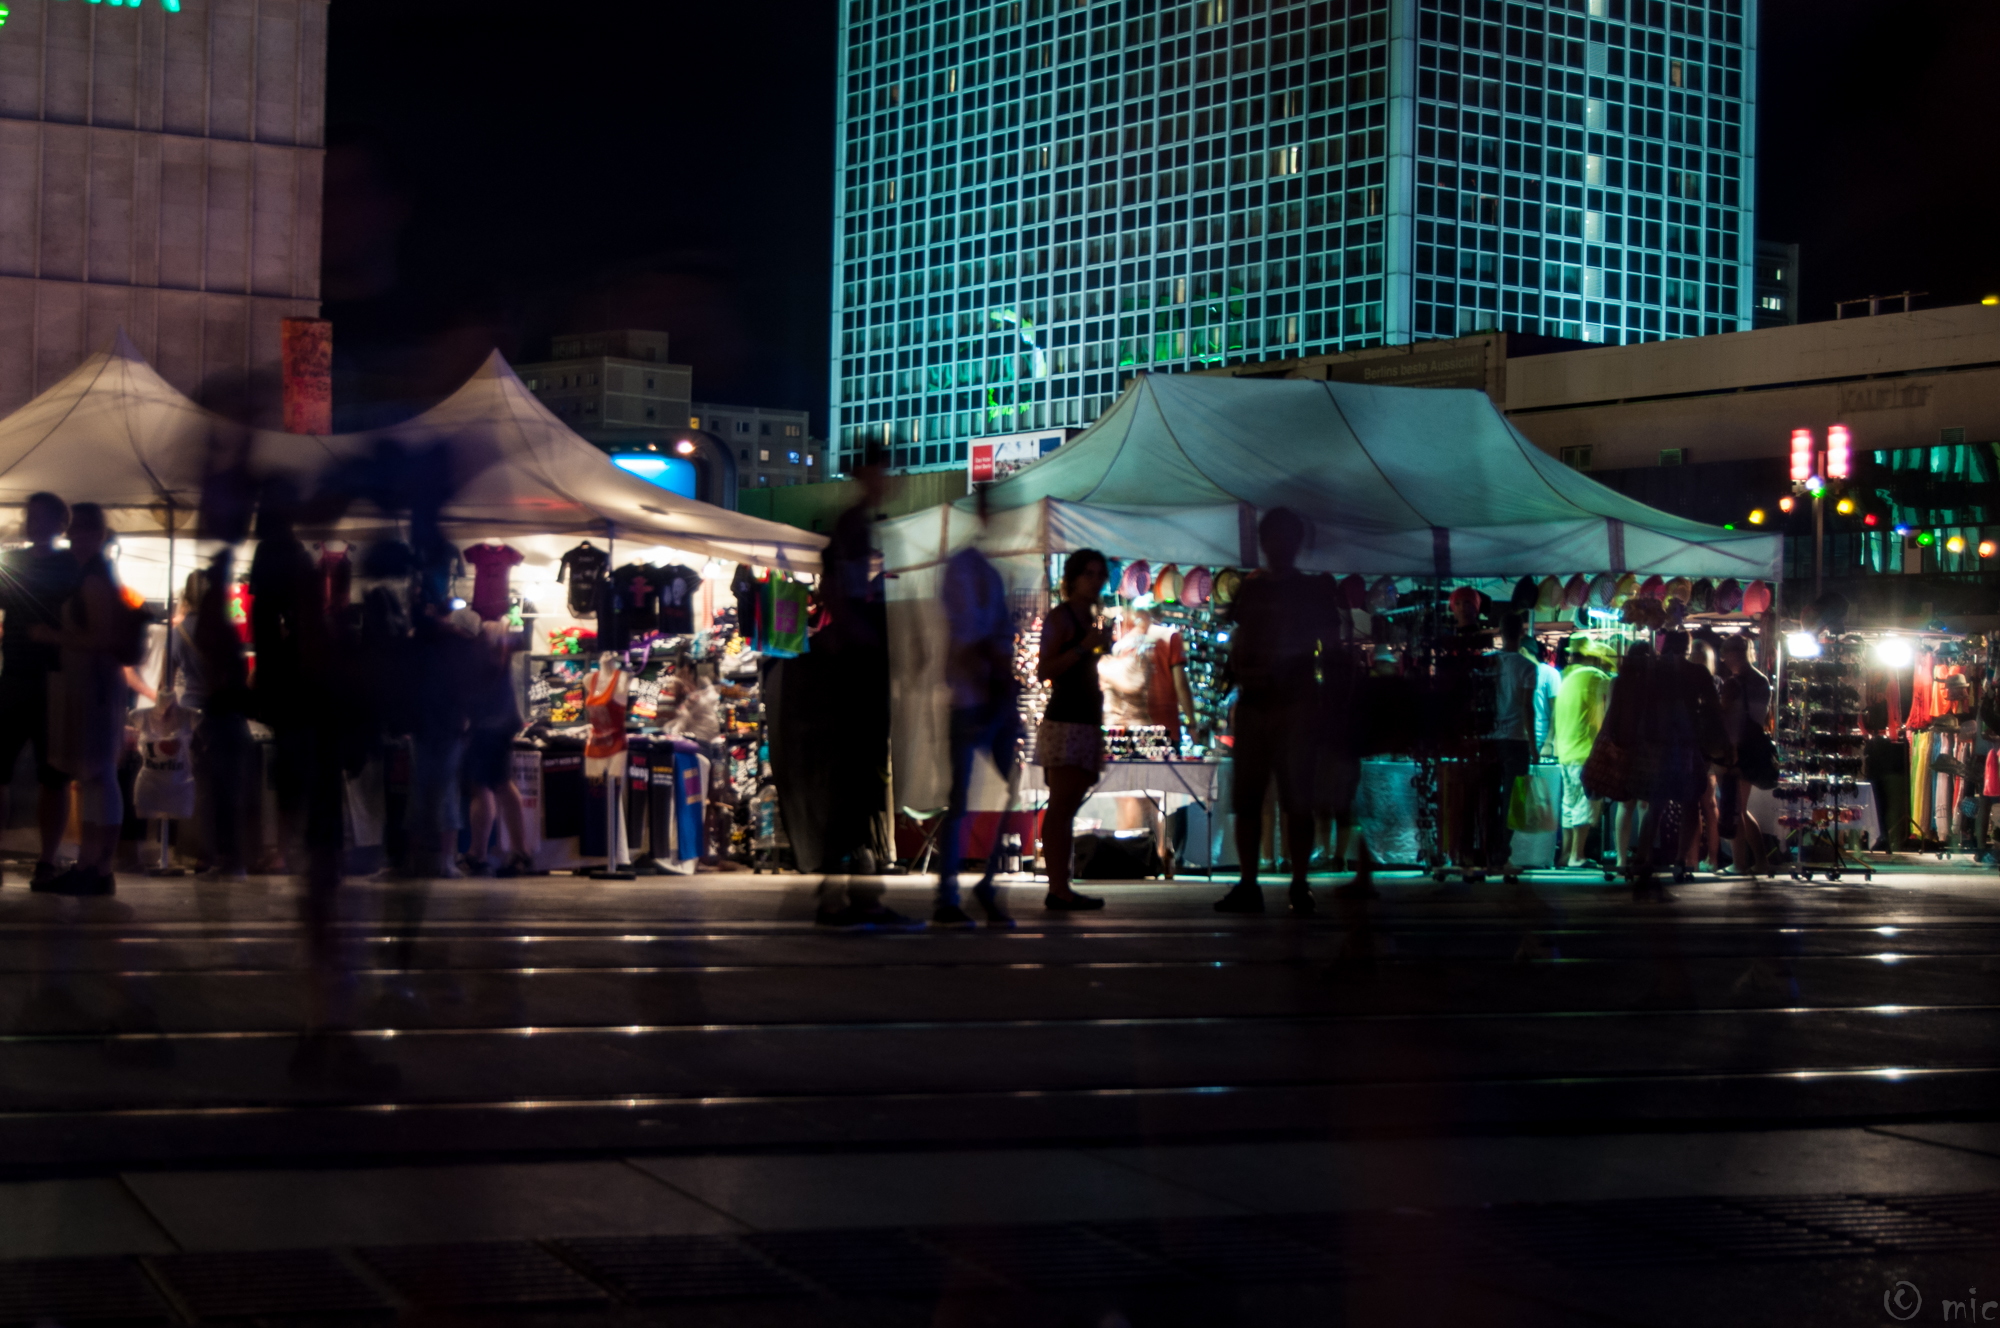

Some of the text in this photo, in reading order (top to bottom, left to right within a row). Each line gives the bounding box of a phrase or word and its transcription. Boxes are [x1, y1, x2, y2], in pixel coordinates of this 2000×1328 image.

[1364, 354, 1478, 379] Berlins beste Aussicht!
